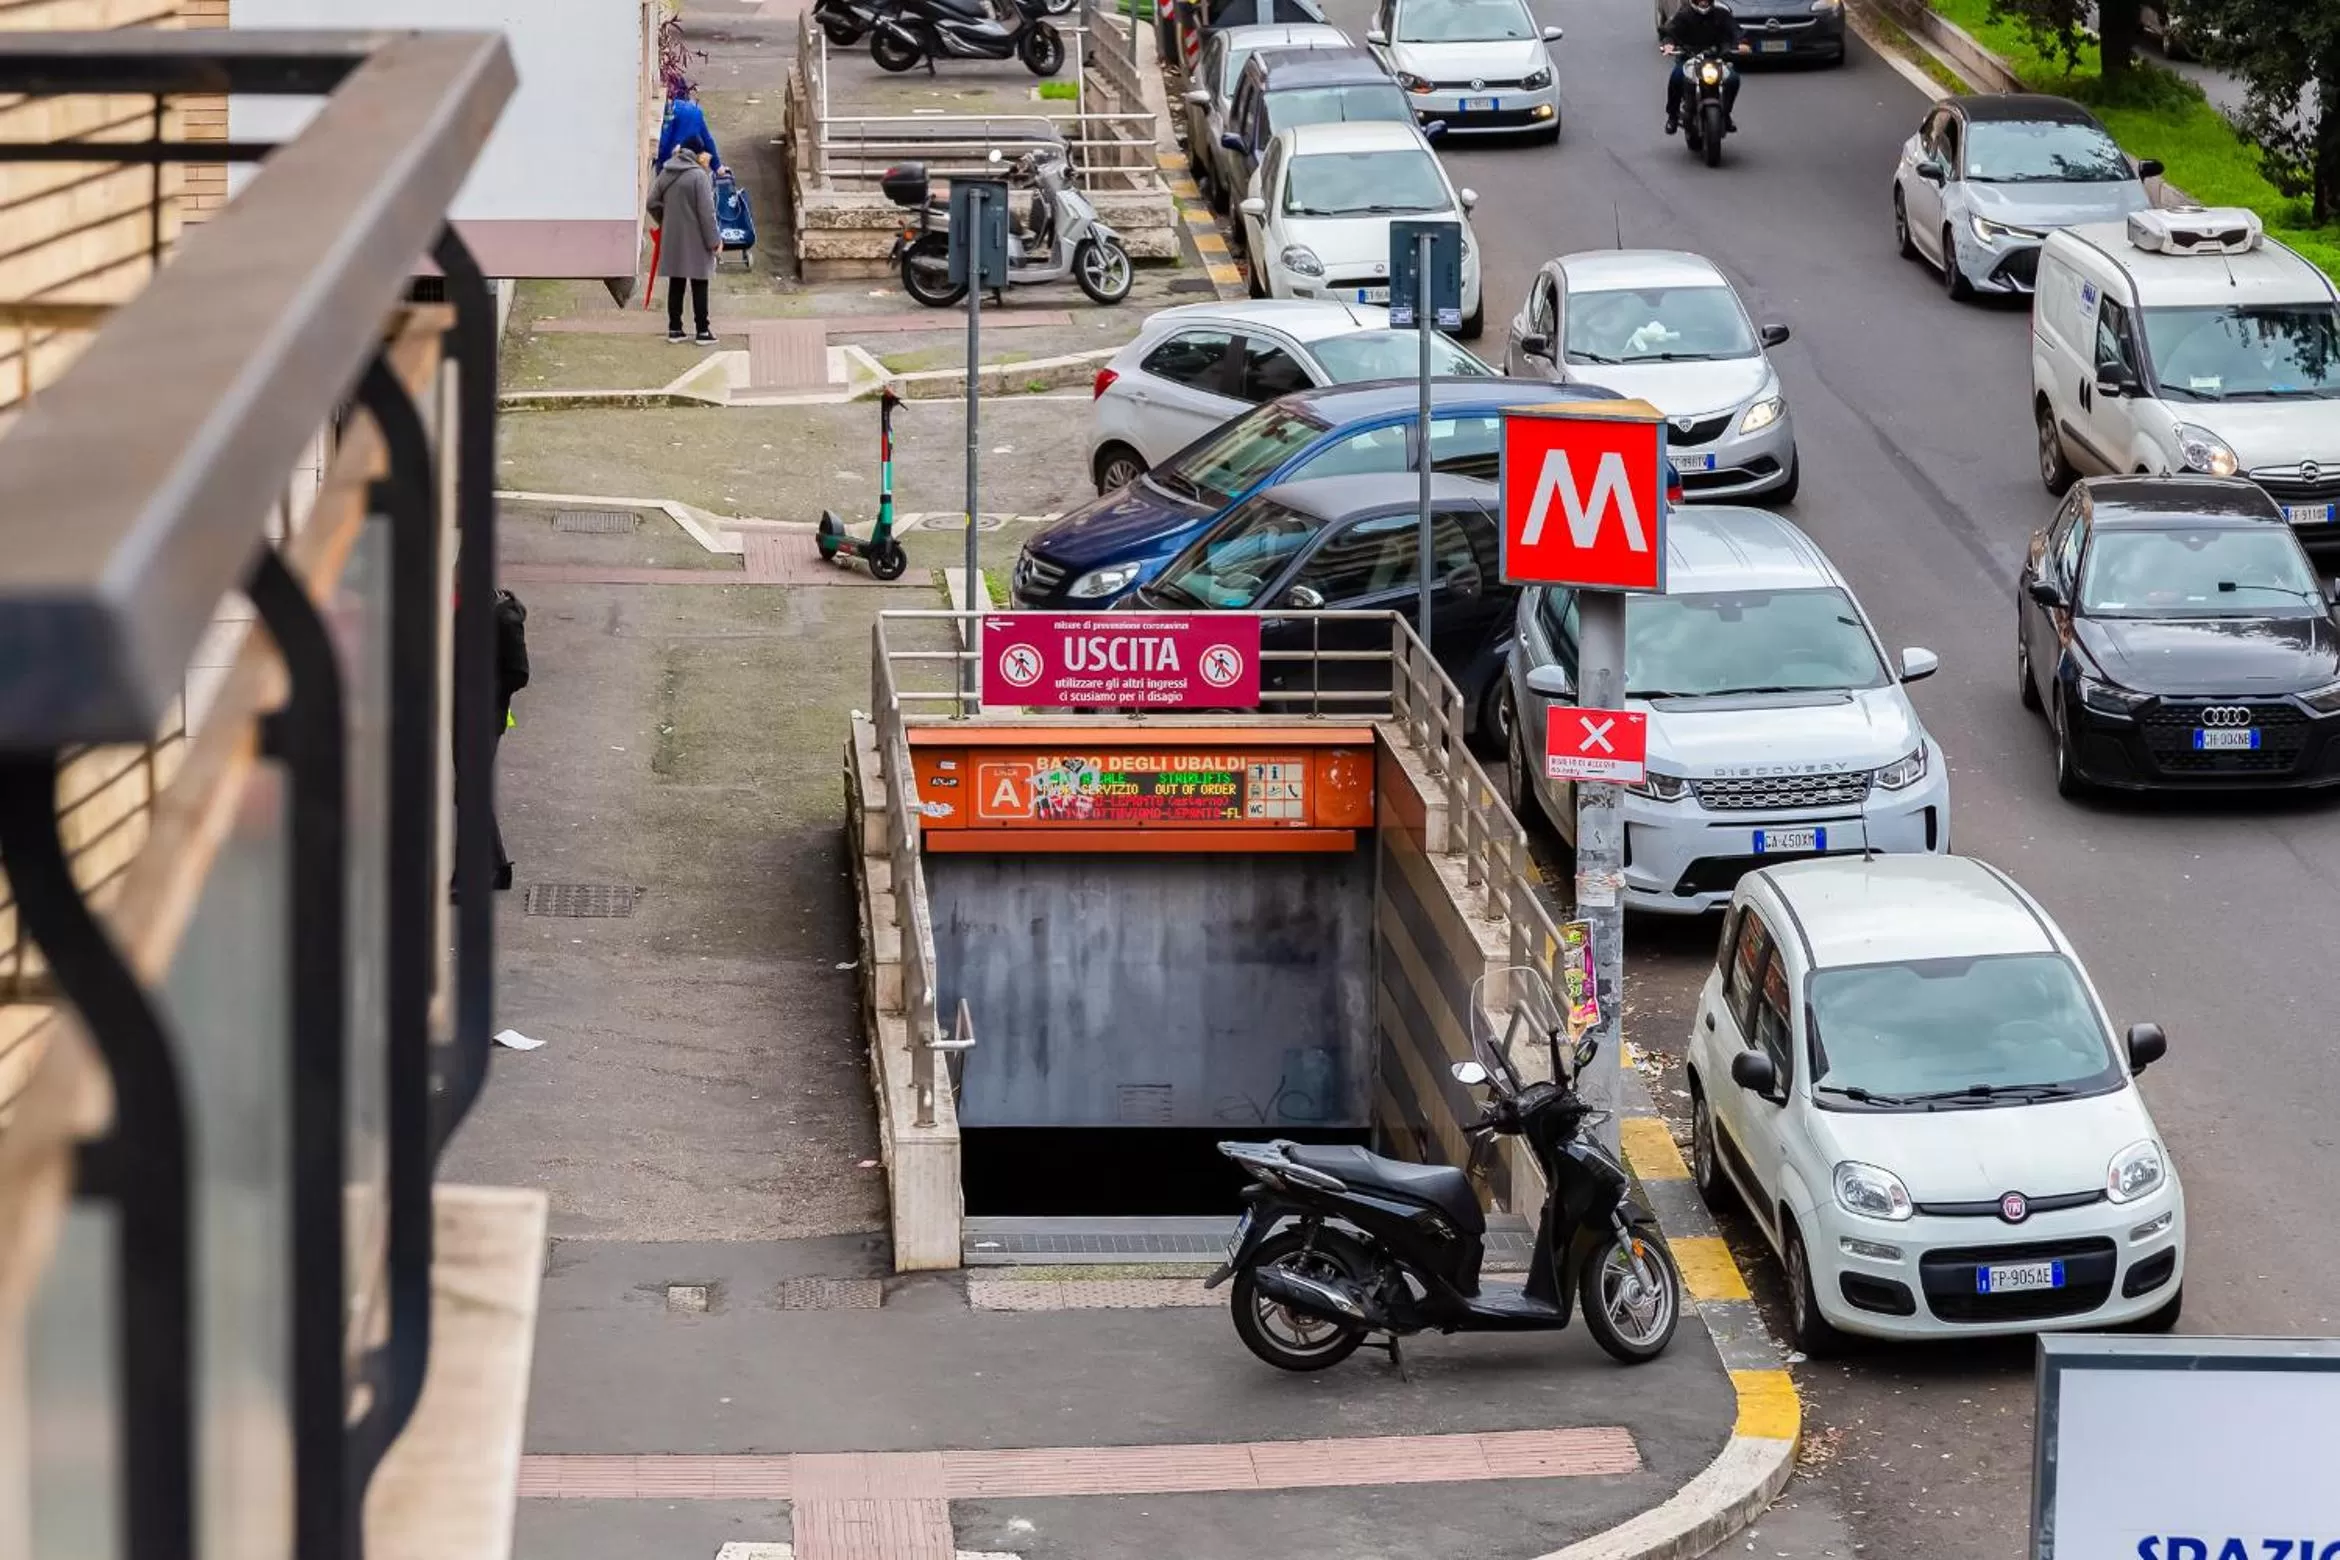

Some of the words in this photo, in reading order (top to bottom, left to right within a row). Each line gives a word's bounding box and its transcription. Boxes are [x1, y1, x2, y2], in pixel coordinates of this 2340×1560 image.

[1520, 448, 1649, 553] M
[1054, 620, 1082, 630] misure
[1083, 620, 1091, 630] di
[1093, 621, 1140, 631] prevenzione
[1142, 621, 1189, 630] coronavirus
[1064, 636, 1180, 672] USCITA
[1055, 677, 1104, 689] utilizzare
[1105, 677, 1119, 690] gli
[1122, 677, 1144, 689] altri
[1147, 677, 1188, 690] ingressi
[1059, 690, 1068, 702] ci
[1070, 690, 1116, 702] scusiamo
[1119, 691, 1136, 704] per
[1138, 690, 1145, 702] il
[1147, 690, 1183, 704] disagio
[1037, 756, 1103, 771] BAO
[1108, 756, 1168, 771] DEGLI
[1173, 756, 1246, 771] UBALDI
[1713, 761, 1848, 777] DISCOVERY
[991, 778, 1021, 808] A
[1154, 783, 1178, 795] OUT
[1182, 783, 1196, 795] OF
[1200, 783, 1237, 795] ORDER
[1249, 804, 1263, 814] WC
